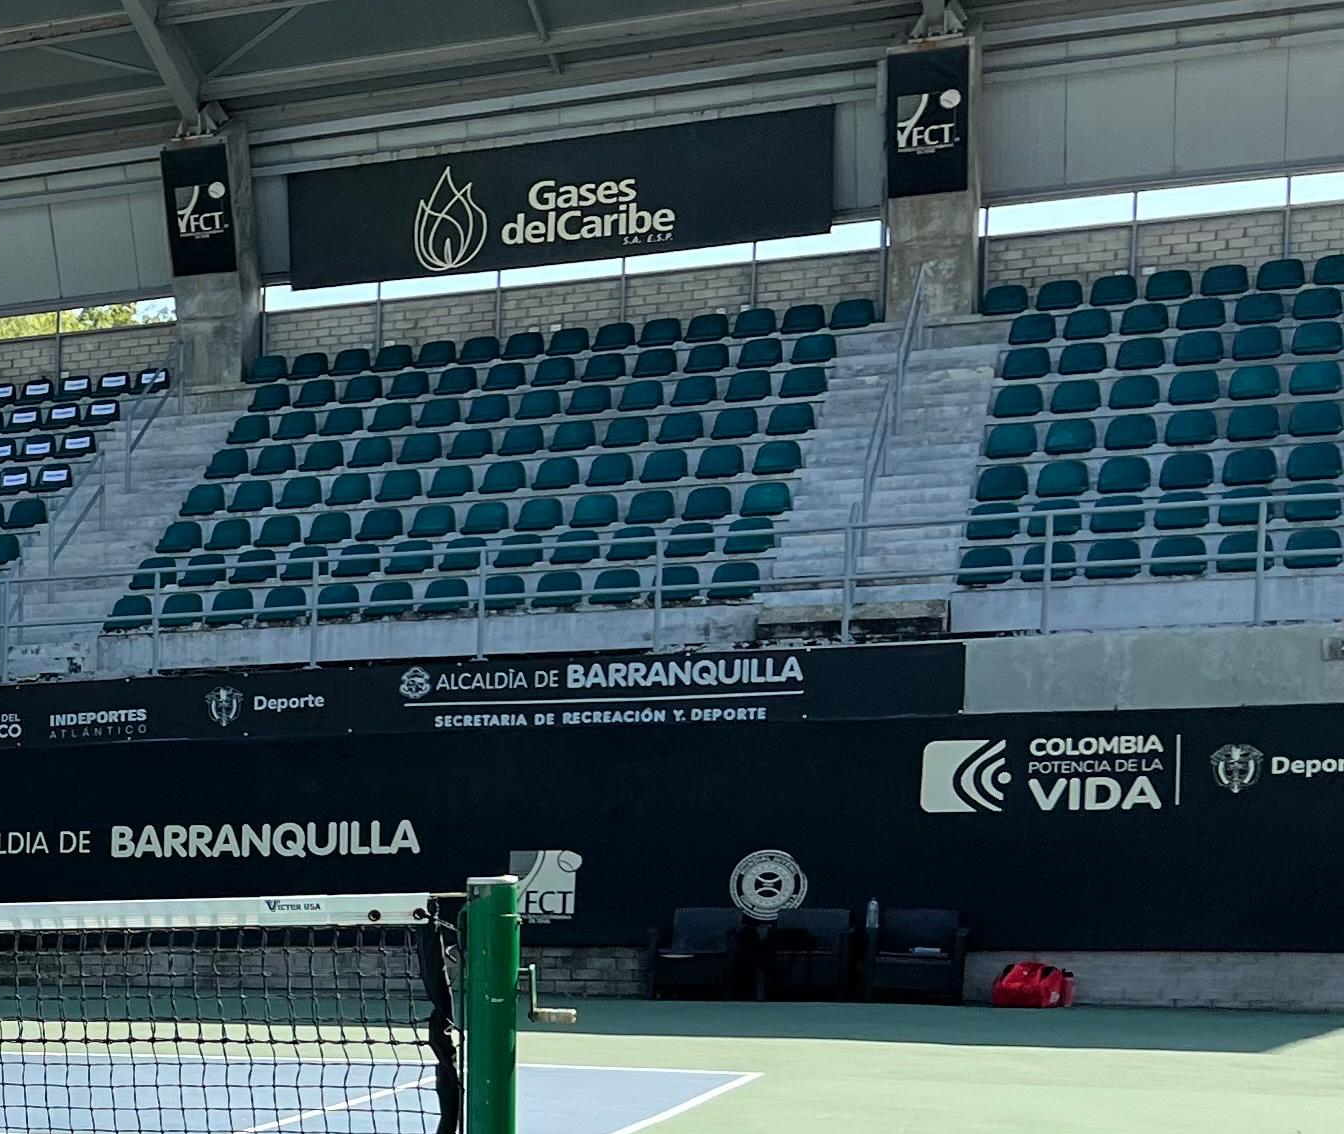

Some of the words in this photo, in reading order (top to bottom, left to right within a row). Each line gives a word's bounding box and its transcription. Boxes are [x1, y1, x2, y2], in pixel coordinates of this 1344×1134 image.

[528, 178, 637, 211] Gases
[501, 203, 676, 245] delCaribe
[534, 669, 560, 689] DE
[566, 655, 804, 689] BARRANQUILLA
[253, 693, 325, 713] Deporte
[1, 712, 21, 723] DEL
[49, 708, 148, 727] INDEPORTES
[434, 713, 528, 728] SECRETARIA
[534, 712, 555, 726] DE
[562, 707, 666, 725] RECREACIÓN
[690, 706, 767, 722] DEPORTE
[1028, 734, 1164, 757] COLOMBIA
[1027, 759, 1112, 775] POTENCIA
[1114, 758, 1138, 774] DE
[1140, 757, 1164, 772] LA
[1027, 775, 1163, 812] VIDA
[59, 830, 92, 855] DE
[111, 818, 421, 859] BARRANQUILLA
[303, 903, 321, 911] USA
[525, 890, 574, 914] FCT
